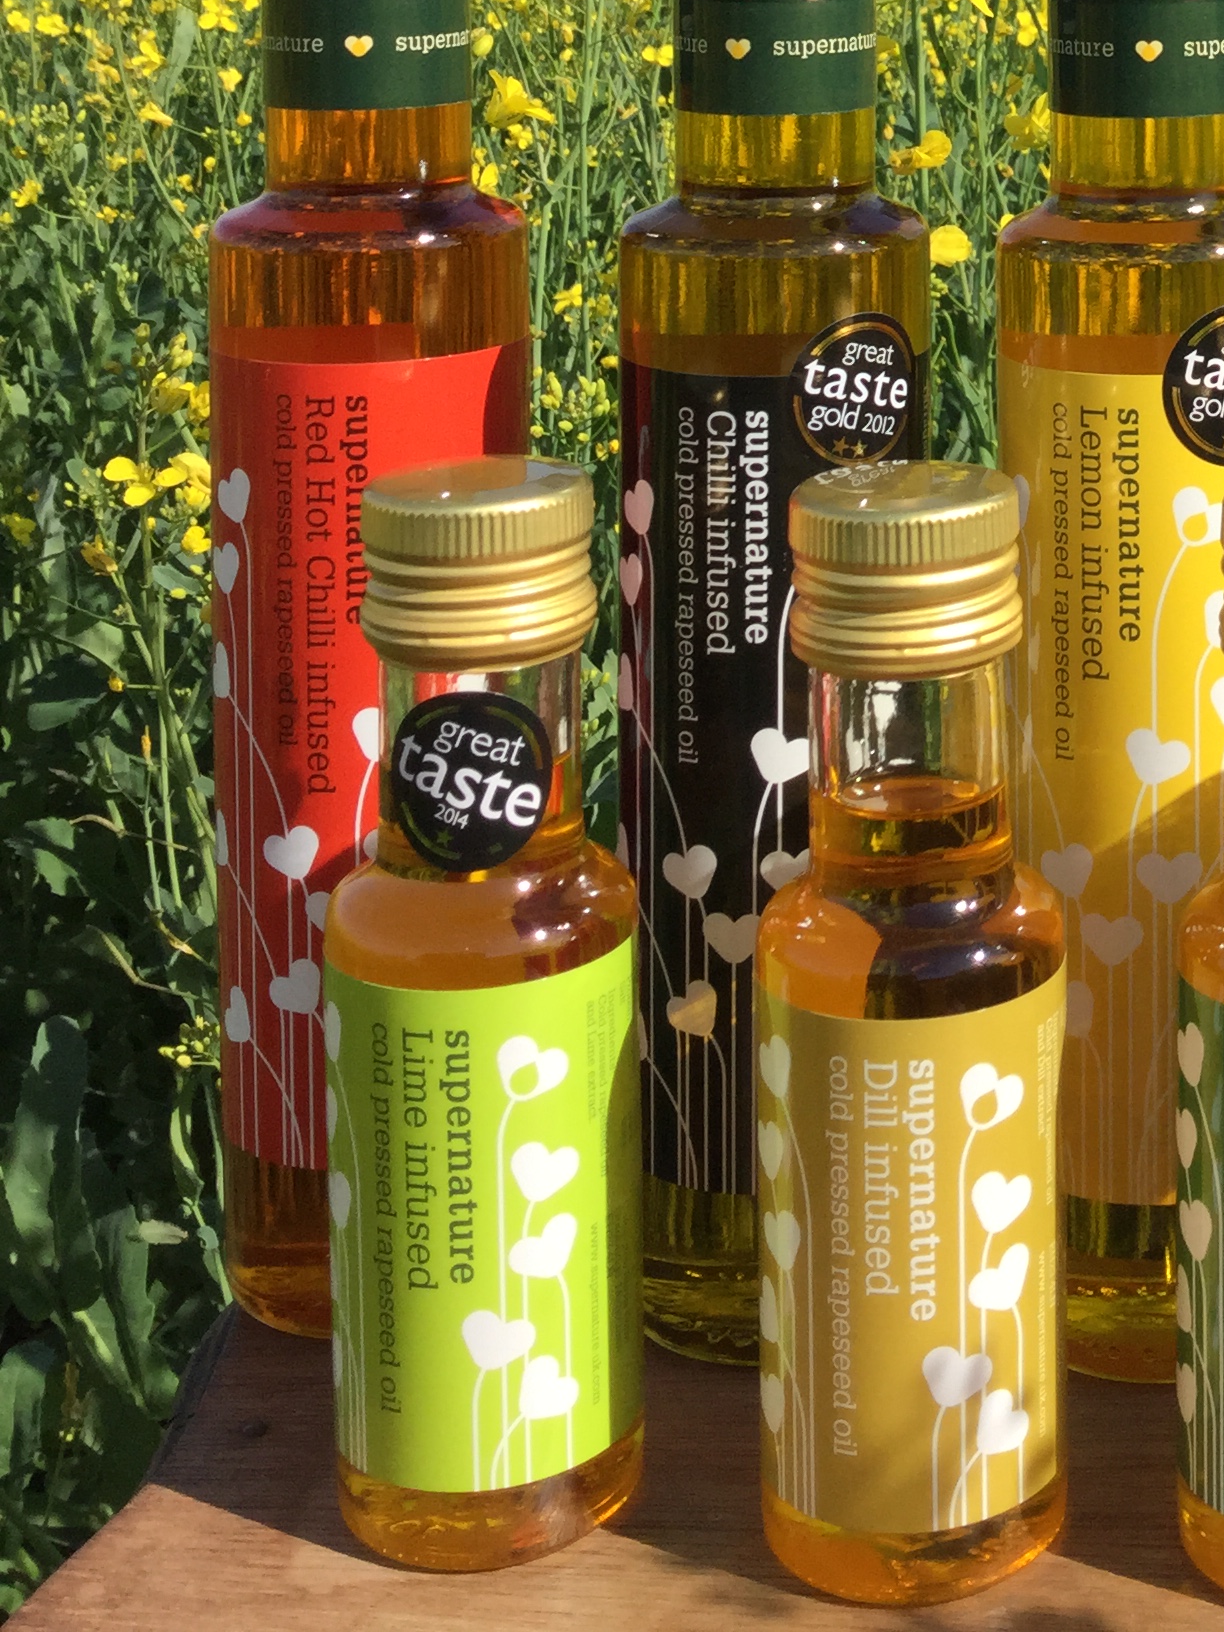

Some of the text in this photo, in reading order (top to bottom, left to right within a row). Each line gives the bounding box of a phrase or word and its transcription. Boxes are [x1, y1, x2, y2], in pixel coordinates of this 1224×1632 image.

[804, 359, 908, 409] taste
[807, 403, 896, 436] gold 2012
[842, 342, 894, 366] great
[273, 394, 298, 746] cold pressed rapeseed oil
[305, 396, 336, 795] Red Hot Chilli infused
[675, 407, 699, 764] cold pressed rapeseed oil
[706, 410, 736, 655] Chilli infused
[740, 411, 773, 644] supernature
[1050, 402, 1074, 760] cold pressed rapeseed oil
[1080, 405, 1109, 680] Lemon infused
[1112, 408, 1144, 642] supernature
[399, 734, 542, 827] taste
[433, 721, 525, 767] great
[434, 804, 469, 830] 2014
[370, 1022, 402, 1413] cold pressed rapeseed oil
[401, 1027, 438, 1290] Lime infused
[439, 1029, 478, 1284] supernature
[825, 1056, 858, 1456] cold pressed rapeseed oil
[863, 1059, 900, 1296] Dill infused
[903, 1058, 940, 1321] supernature
